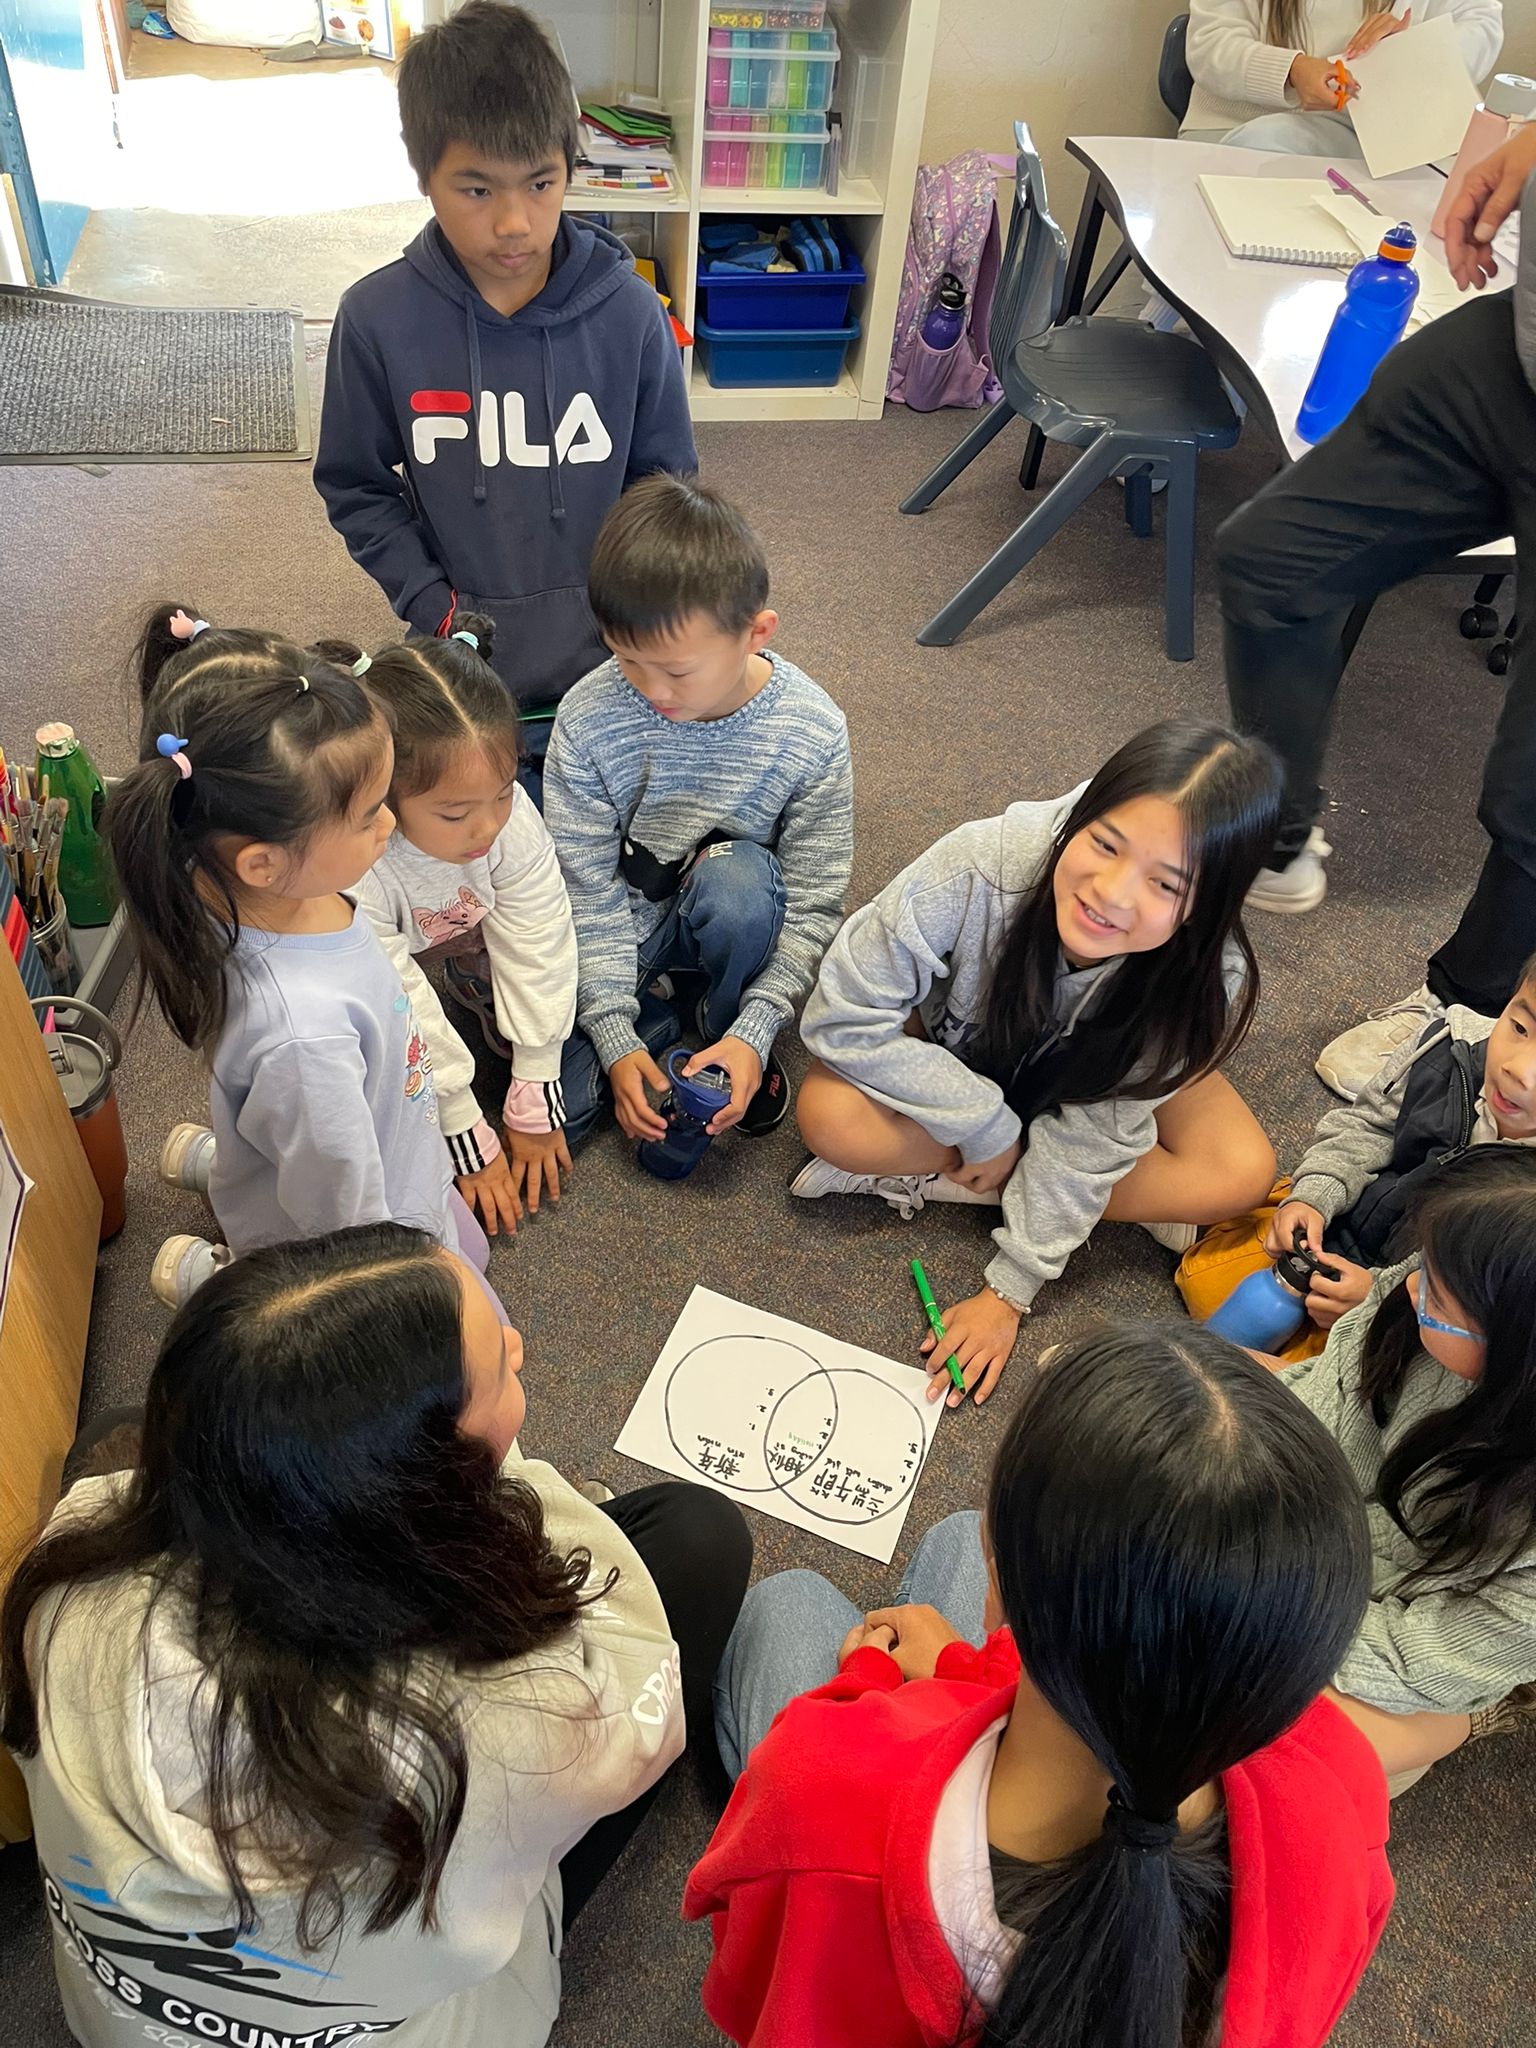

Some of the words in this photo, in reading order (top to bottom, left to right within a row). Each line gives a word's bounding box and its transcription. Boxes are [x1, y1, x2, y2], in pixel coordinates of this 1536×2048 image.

[410, 389, 613, 468] FILA
[769, 1073, 780, 1098] FILA
[698, 1446, 741, 1480] 新年
[162, 1998, 390, 2048] COUNTRY
